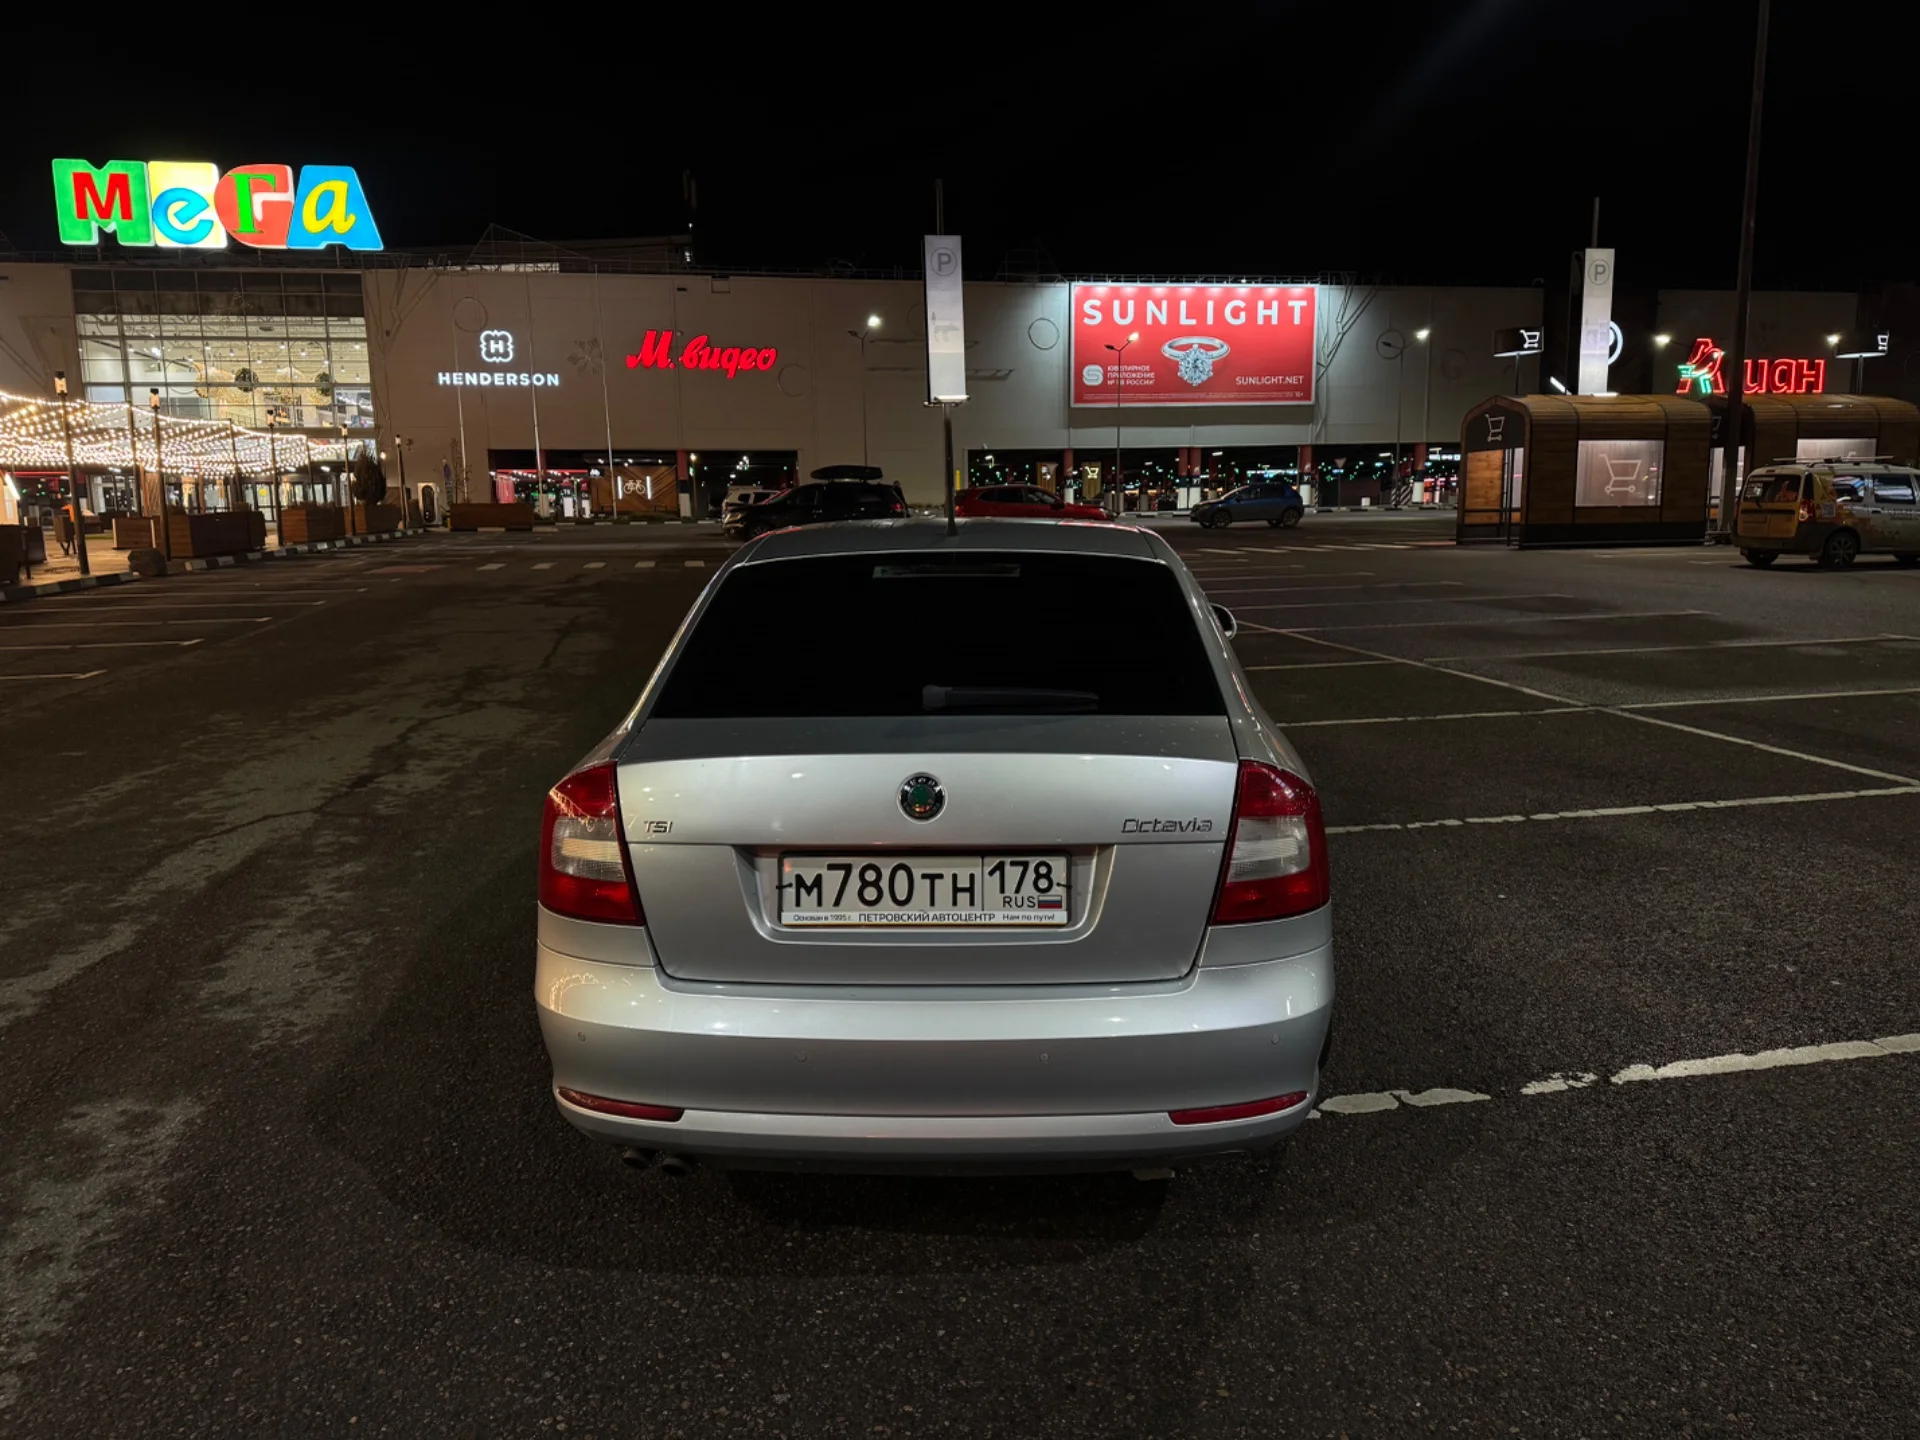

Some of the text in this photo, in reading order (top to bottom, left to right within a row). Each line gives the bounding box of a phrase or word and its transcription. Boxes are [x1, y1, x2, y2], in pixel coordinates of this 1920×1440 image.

[1083, 299, 1307, 325] SUNLIGHT
[437, 372, 560, 386] HENDERSON
[1236, 375, 1304, 385] SUNLIGHT.NET
[643, 820, 673, 833] TSI
[1121, 817, 1213, 833] Octavia
[987, 860, 1054, 895] 178
[1002, 895, 1036, 908] RUS
[858, 911, 930, 923] ПЕТРОВСКИЙ
[931, 913, 995, 923] АВТОЦЕНТР
[1002, 913, 1020, 921] Нам
